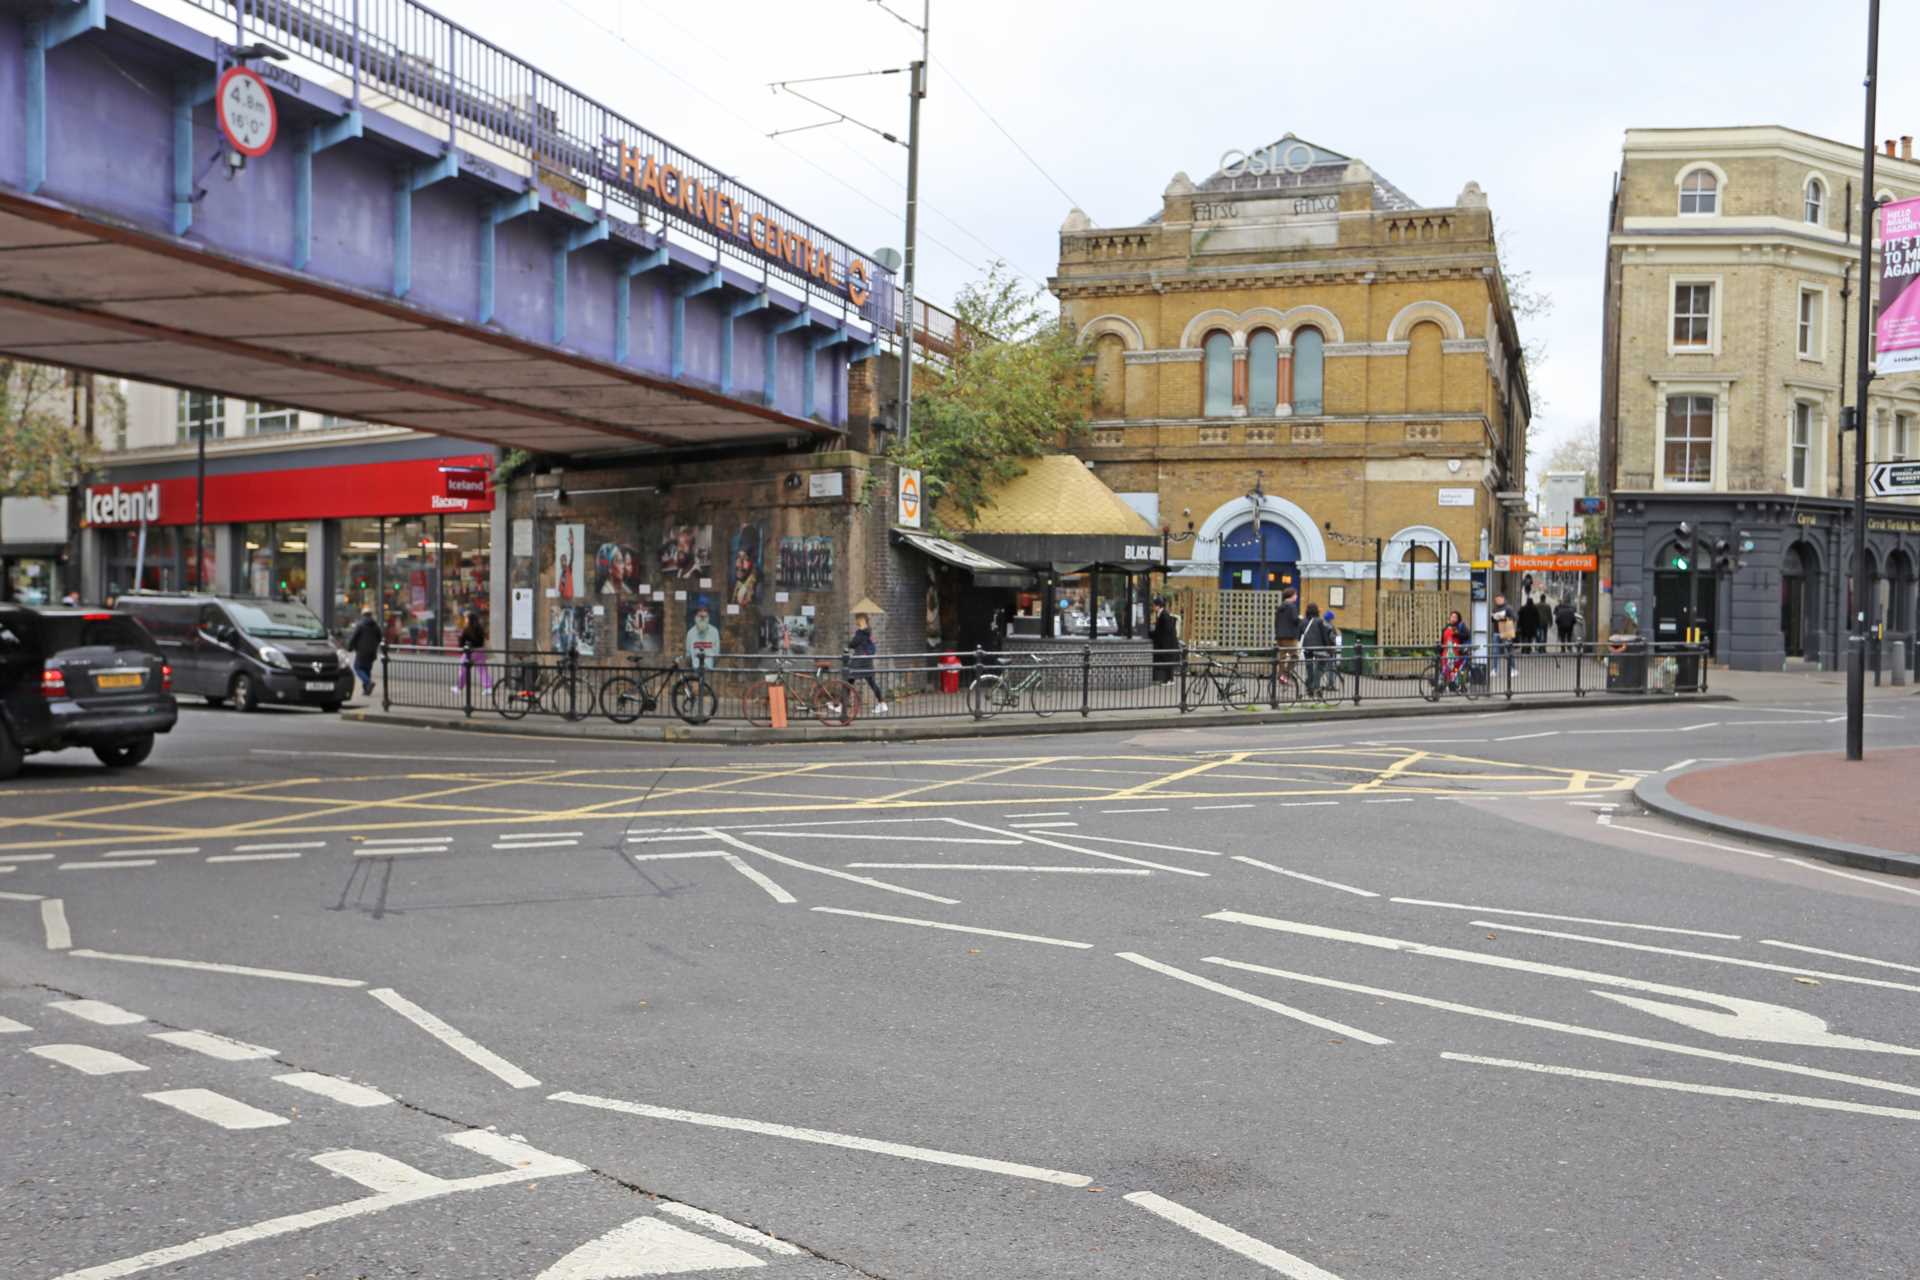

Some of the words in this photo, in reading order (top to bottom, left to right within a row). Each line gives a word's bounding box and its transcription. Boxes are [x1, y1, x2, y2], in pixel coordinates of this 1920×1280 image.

[1220, 143, 1314, 178] OSLO
[619, 139, 744, 236] HACKNEY
[751, 213, 840, 287] CENTRAL
[1885, 237, 1910, 252] IT'S
[1884, 250, 1901, 265] TO
[447, 480, 484, 491] Iceland
[86, 483, 159, 523] Iceland
[1125, 545, 1149, 560] BLACK
[1513, 558, 1553, 569] Hackney
[1556, 558, 1592, 568] Central
